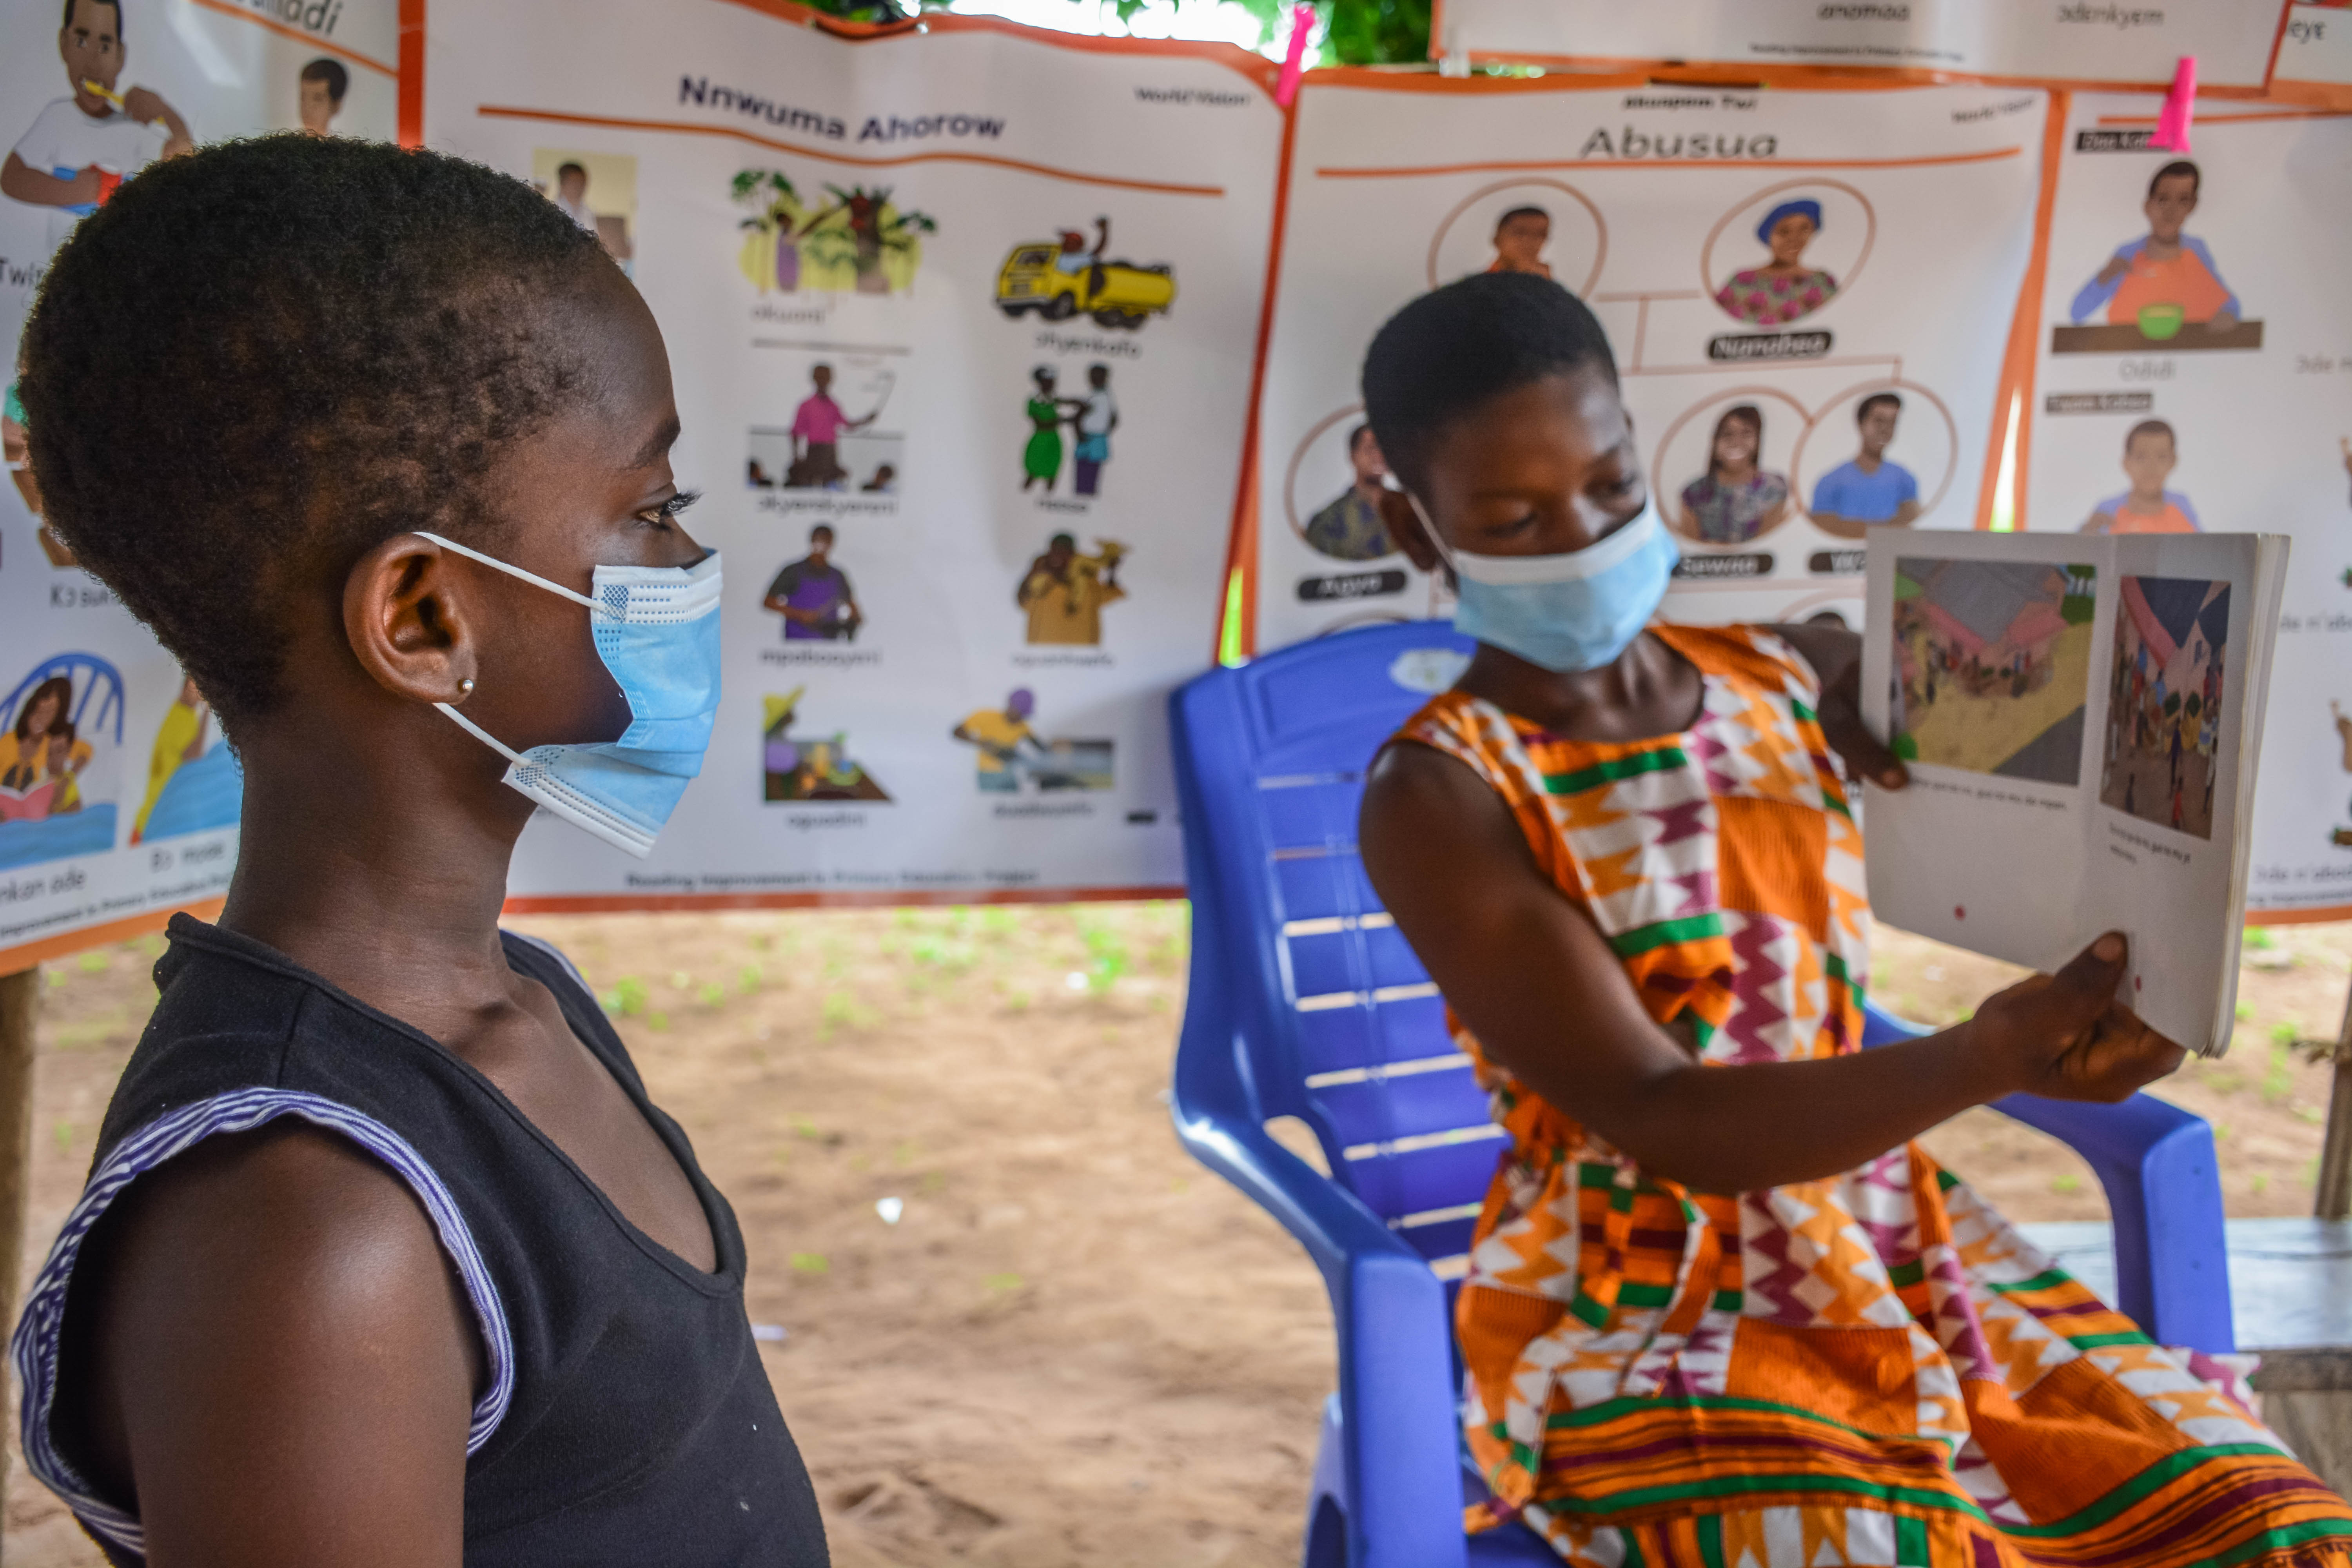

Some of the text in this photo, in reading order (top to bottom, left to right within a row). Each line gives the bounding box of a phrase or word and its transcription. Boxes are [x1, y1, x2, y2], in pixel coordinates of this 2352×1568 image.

[679, 76, 1005, 143] Nnwuma Ahorow
[1581, 125, 1777, 158] Abusua
